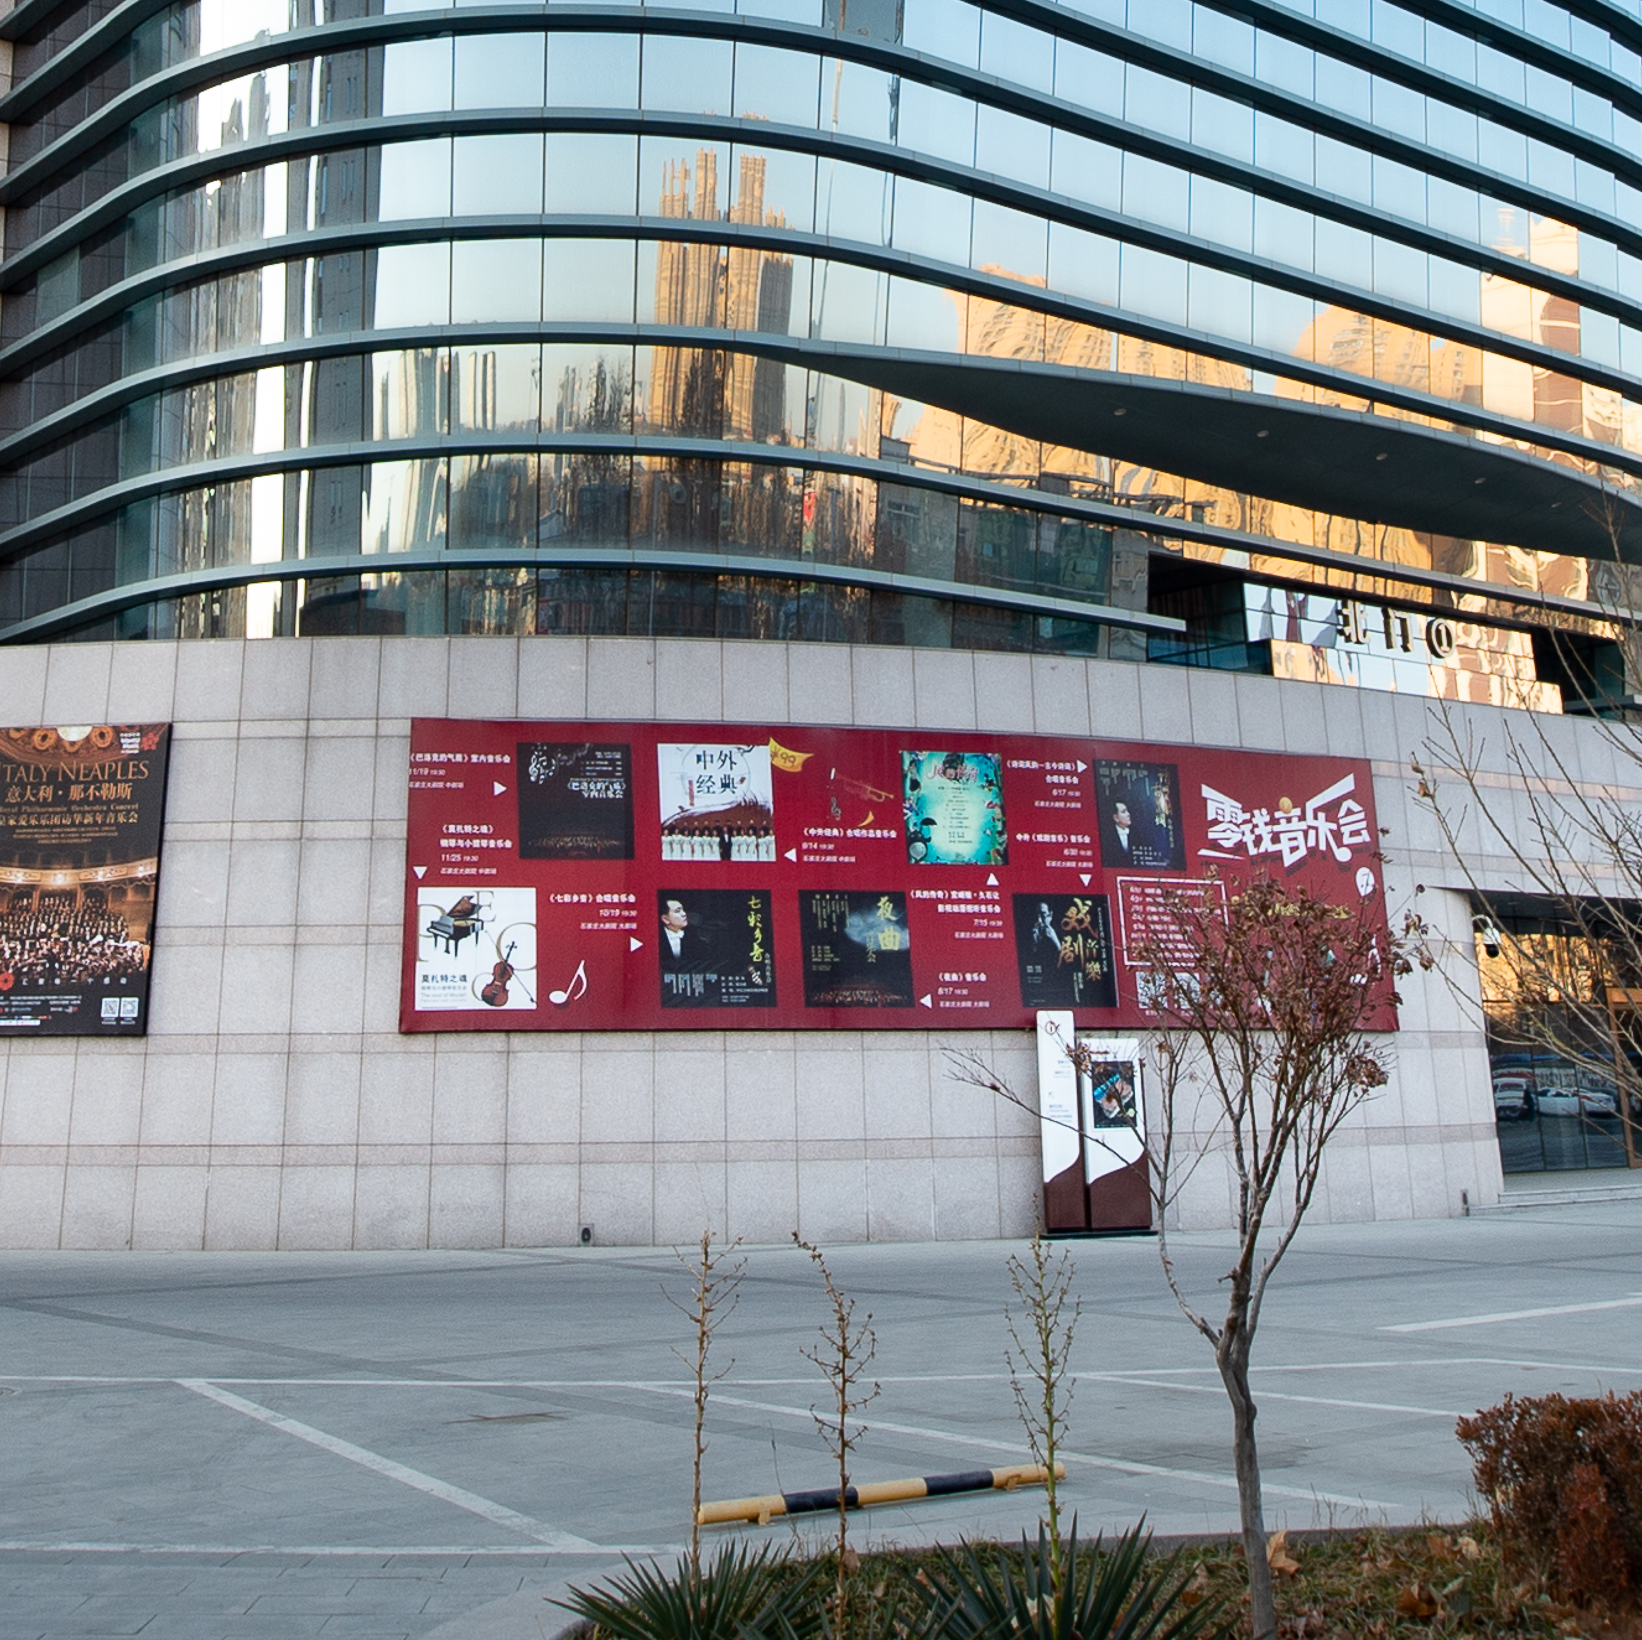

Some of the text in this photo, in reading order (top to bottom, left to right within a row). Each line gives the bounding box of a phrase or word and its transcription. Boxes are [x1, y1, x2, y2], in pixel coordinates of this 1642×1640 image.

[58, 760, 150, 781] NEAPLES
[696, 750, 737, 771] 中外
[5, 782, 133, 803] 意大利·那不勒斯
[695, 774, 737, 795] 经典
[1197, 773, 1371, 867] 零钱音乐会
[877, 896, 901, 951] 夜曲
[422, 974, 467, 983] 莫扎特之魂
